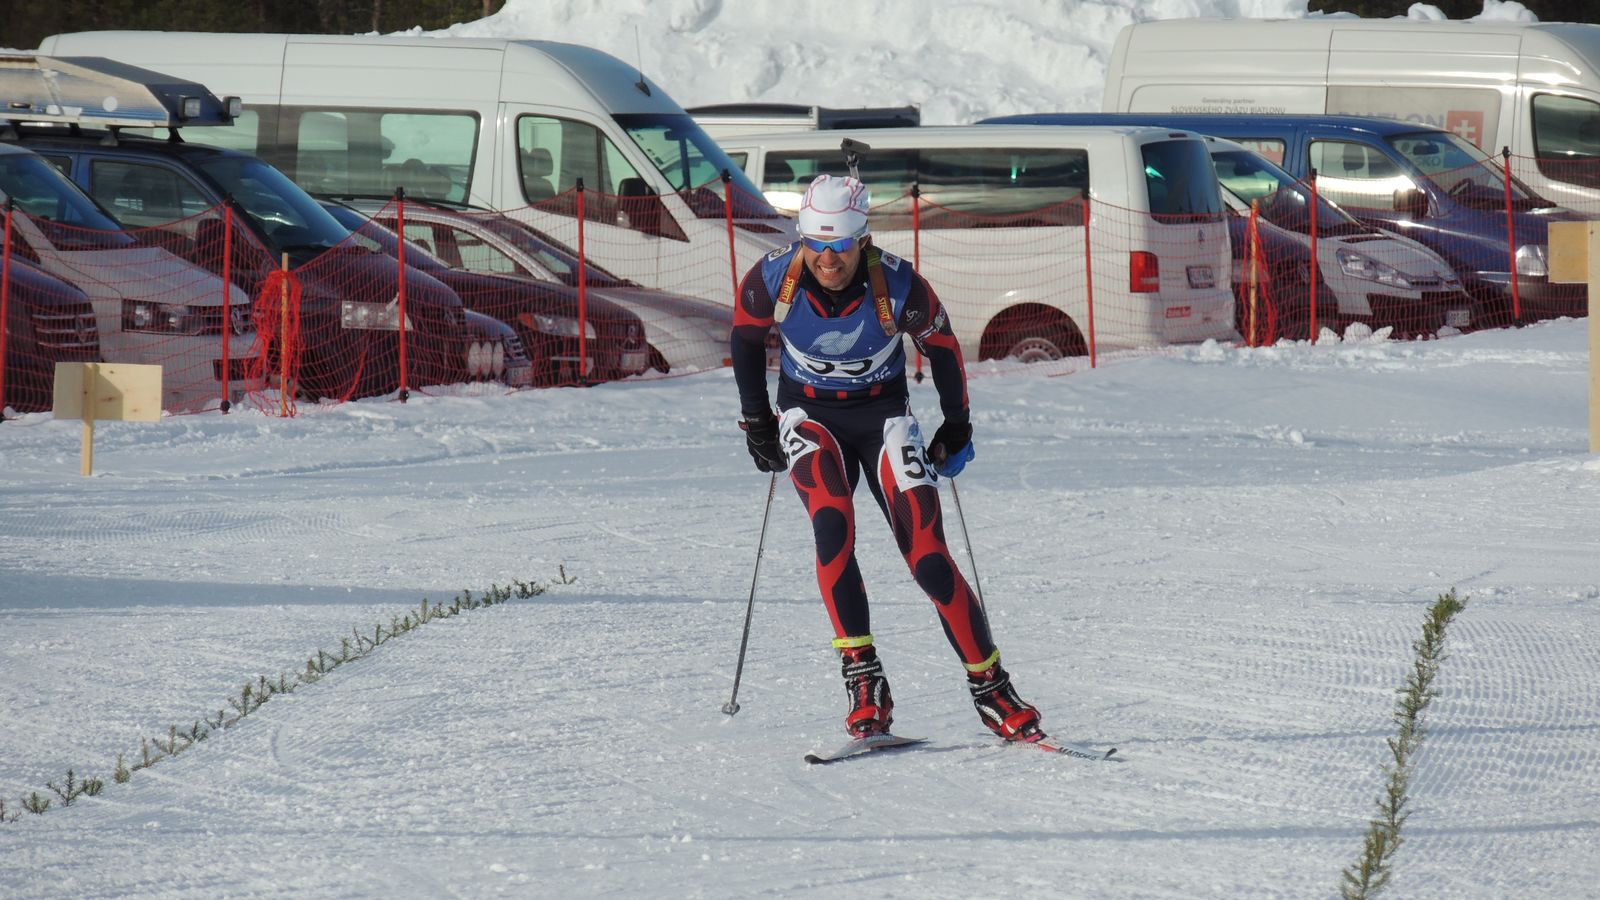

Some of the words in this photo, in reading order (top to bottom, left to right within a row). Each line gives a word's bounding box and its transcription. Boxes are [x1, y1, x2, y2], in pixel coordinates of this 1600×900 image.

[1250, 105, 1286, 114] BIATLONU
[781, 276, 794, 303] START
[878, 296, 890, 321] START
